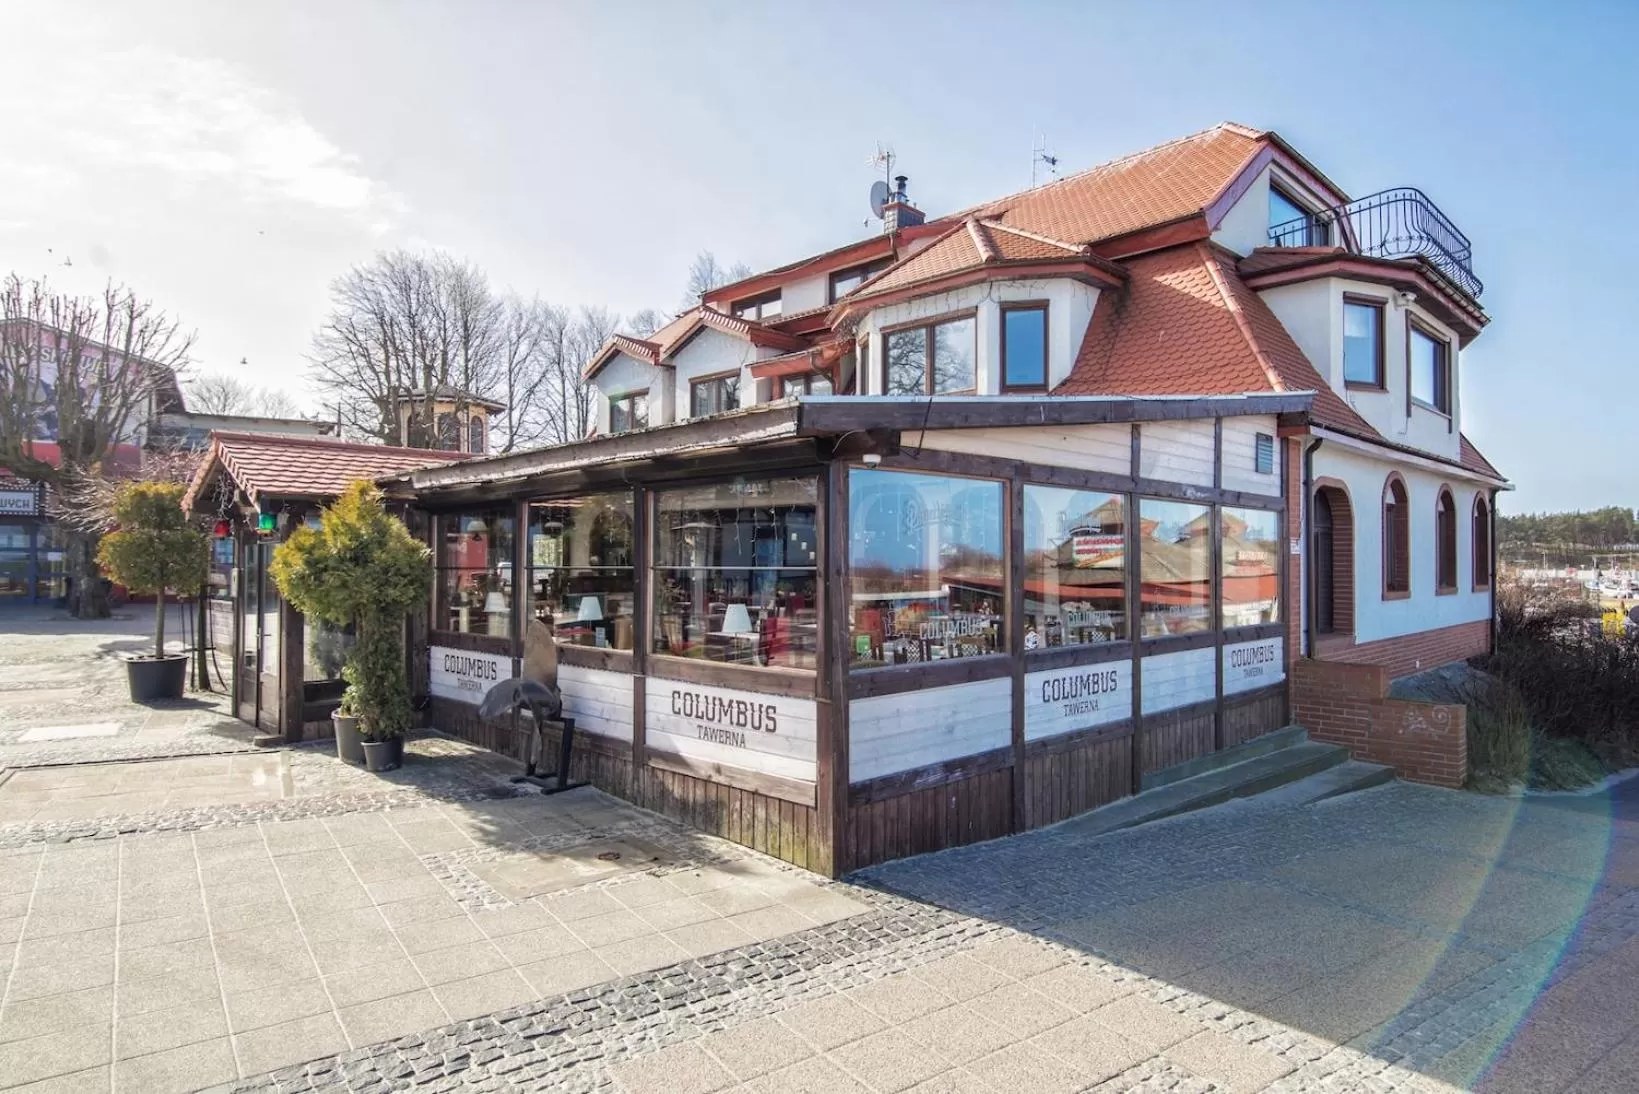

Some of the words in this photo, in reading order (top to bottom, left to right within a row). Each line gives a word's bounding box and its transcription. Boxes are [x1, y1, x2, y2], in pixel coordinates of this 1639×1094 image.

[444, 654, 497, 681] COLUMBUS
[1231, 644, 1274, 668] COLUMBUS
[1042, 670, 1118, 703] COLUMBUS
[672, 690, 777, 733] COLUMBUS
[1063, 699, 1099, 717] TAWERNA
[696, 725, 746, 748] TAWERNA
